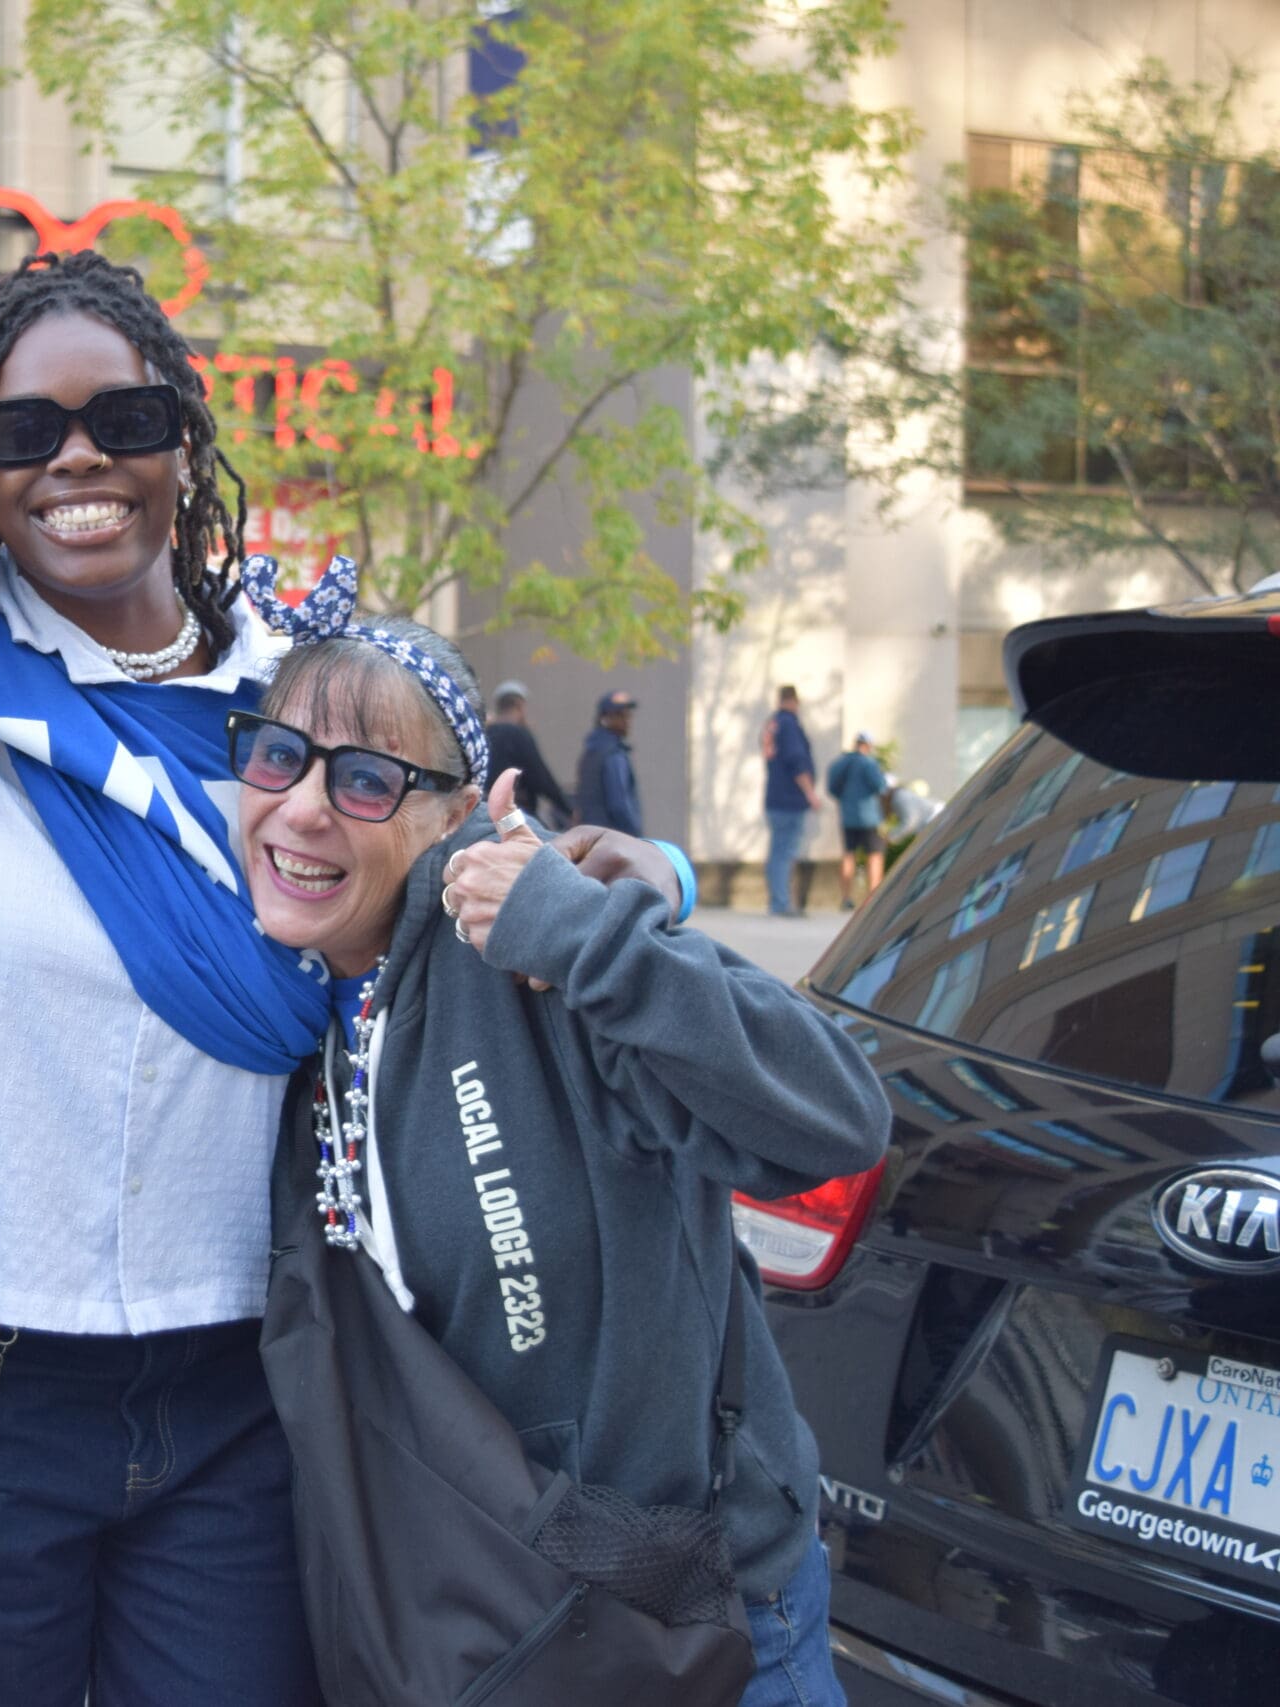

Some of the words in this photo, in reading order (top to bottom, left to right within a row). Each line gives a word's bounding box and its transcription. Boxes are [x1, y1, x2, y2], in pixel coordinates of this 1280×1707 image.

[451, 1060, 503, 1165] LOCAL
[473, 1168, 535, 1270] LODGE
[1176, 1183, 1280, 1252] KIA
[499, 1274, 547, 1353] 2323
[1093, 1392, 1238, 1517] CJXA
[1077, 1489, 1243, 1560] Georgetown
